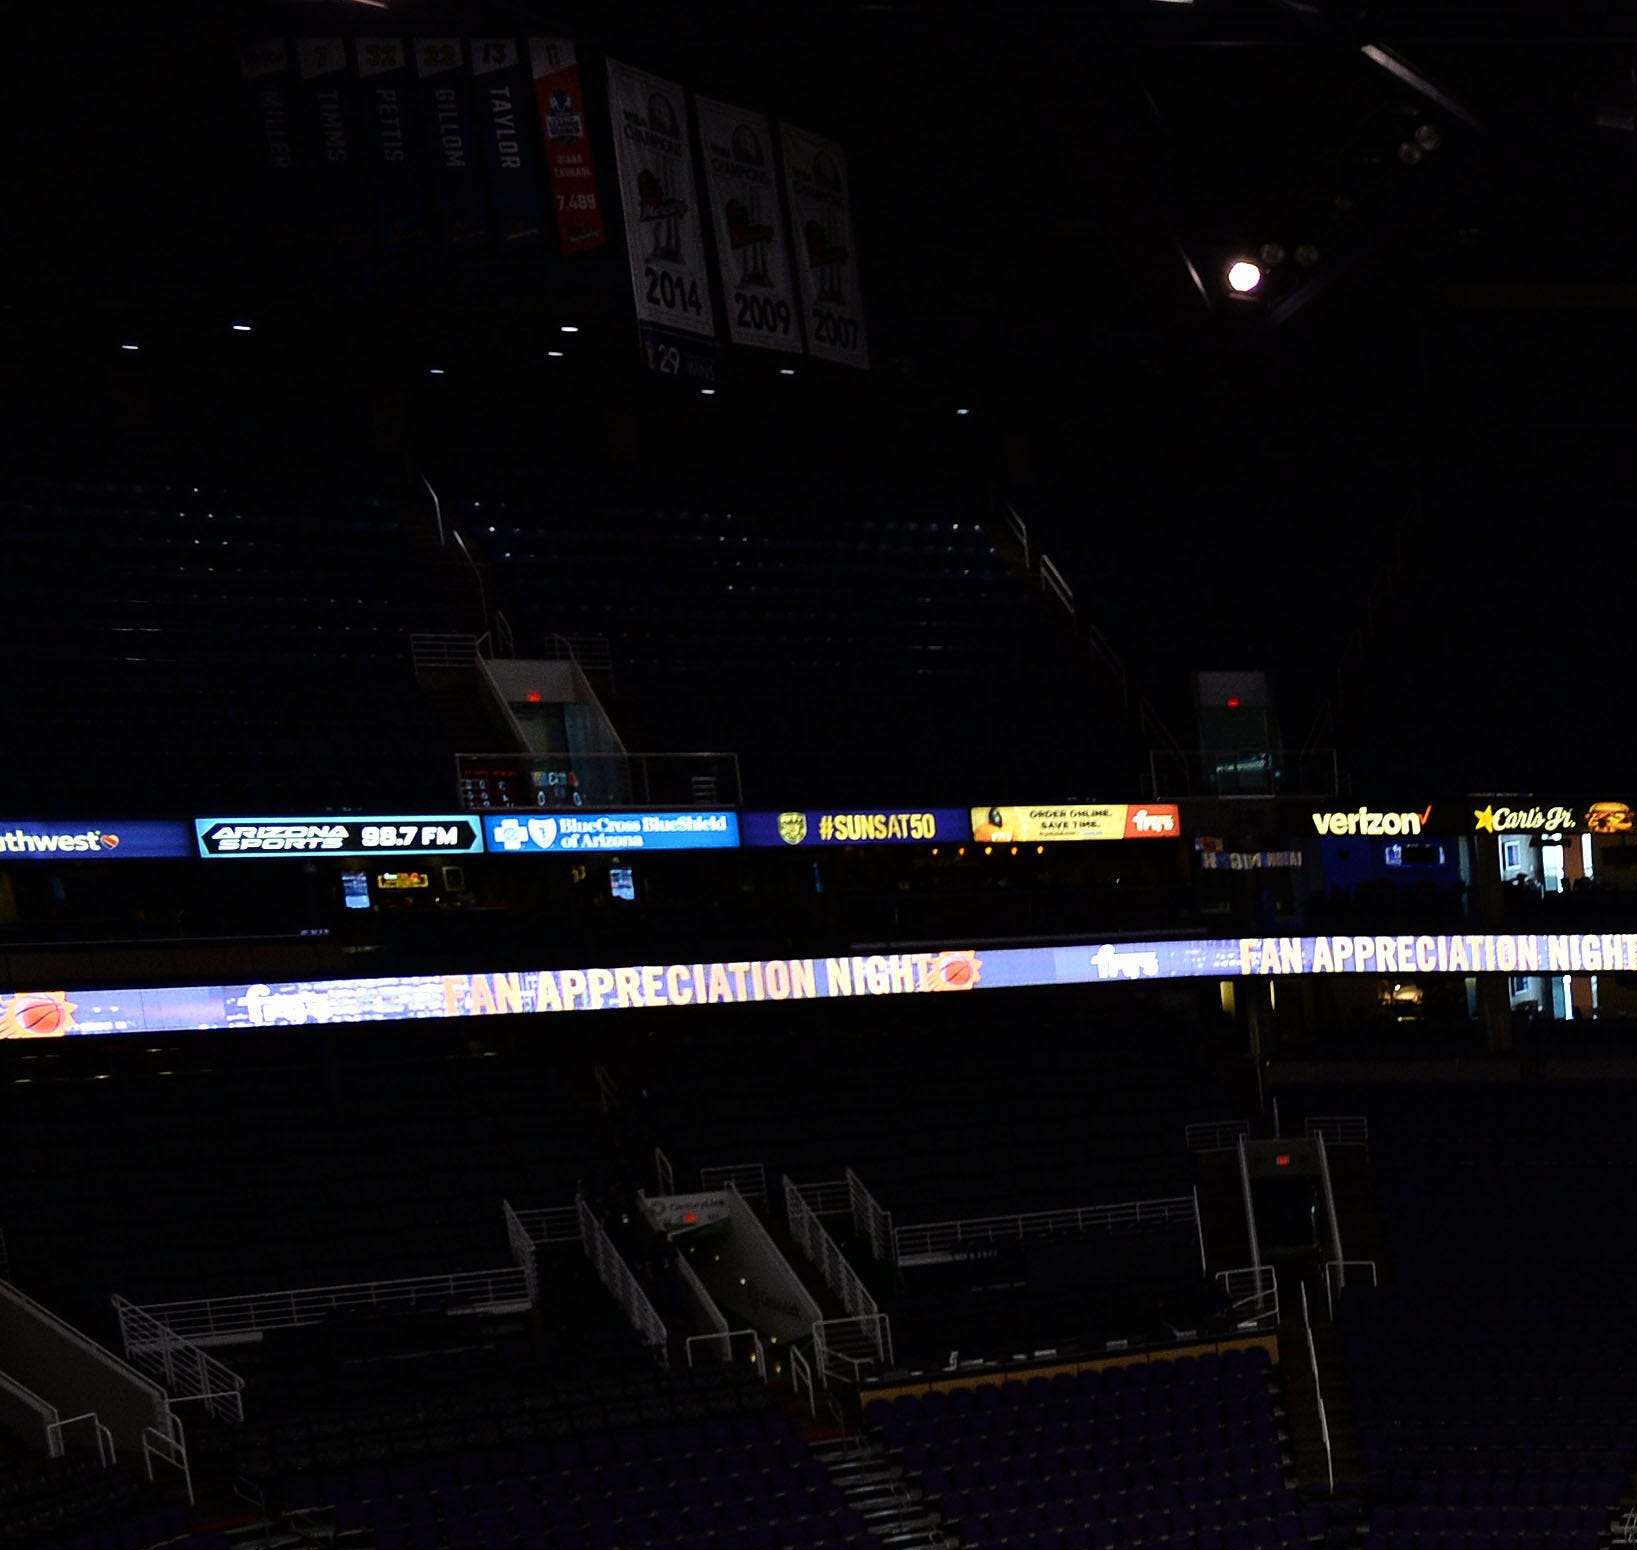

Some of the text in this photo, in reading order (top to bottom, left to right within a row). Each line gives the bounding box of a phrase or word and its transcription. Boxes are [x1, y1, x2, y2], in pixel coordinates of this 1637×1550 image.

[489, 84, 523, 169] TAYLOR
[645, 267, 702, 317] 2014
[735, 292, 791, 334] 2009
[812, 308, 858, 349] 2007
[211, 826, 458, 846] ARIZONA 98.7 FM
[560, 814, 728, 833] BlueCross BlueShield
[818, 813, 935, 841] #SUNSAT50
[1312, 807, 1423, 835] verizon
[218, 838, 344, 850] SPORTS
[561, 833, 643, 848] of Arizona
[1240, 937, 1301, 974] FAN
[1313, 935, 1537, 973] APPRECIATION
[444, 953, 932, 1017] FAN APPRECIATION NIGHT
